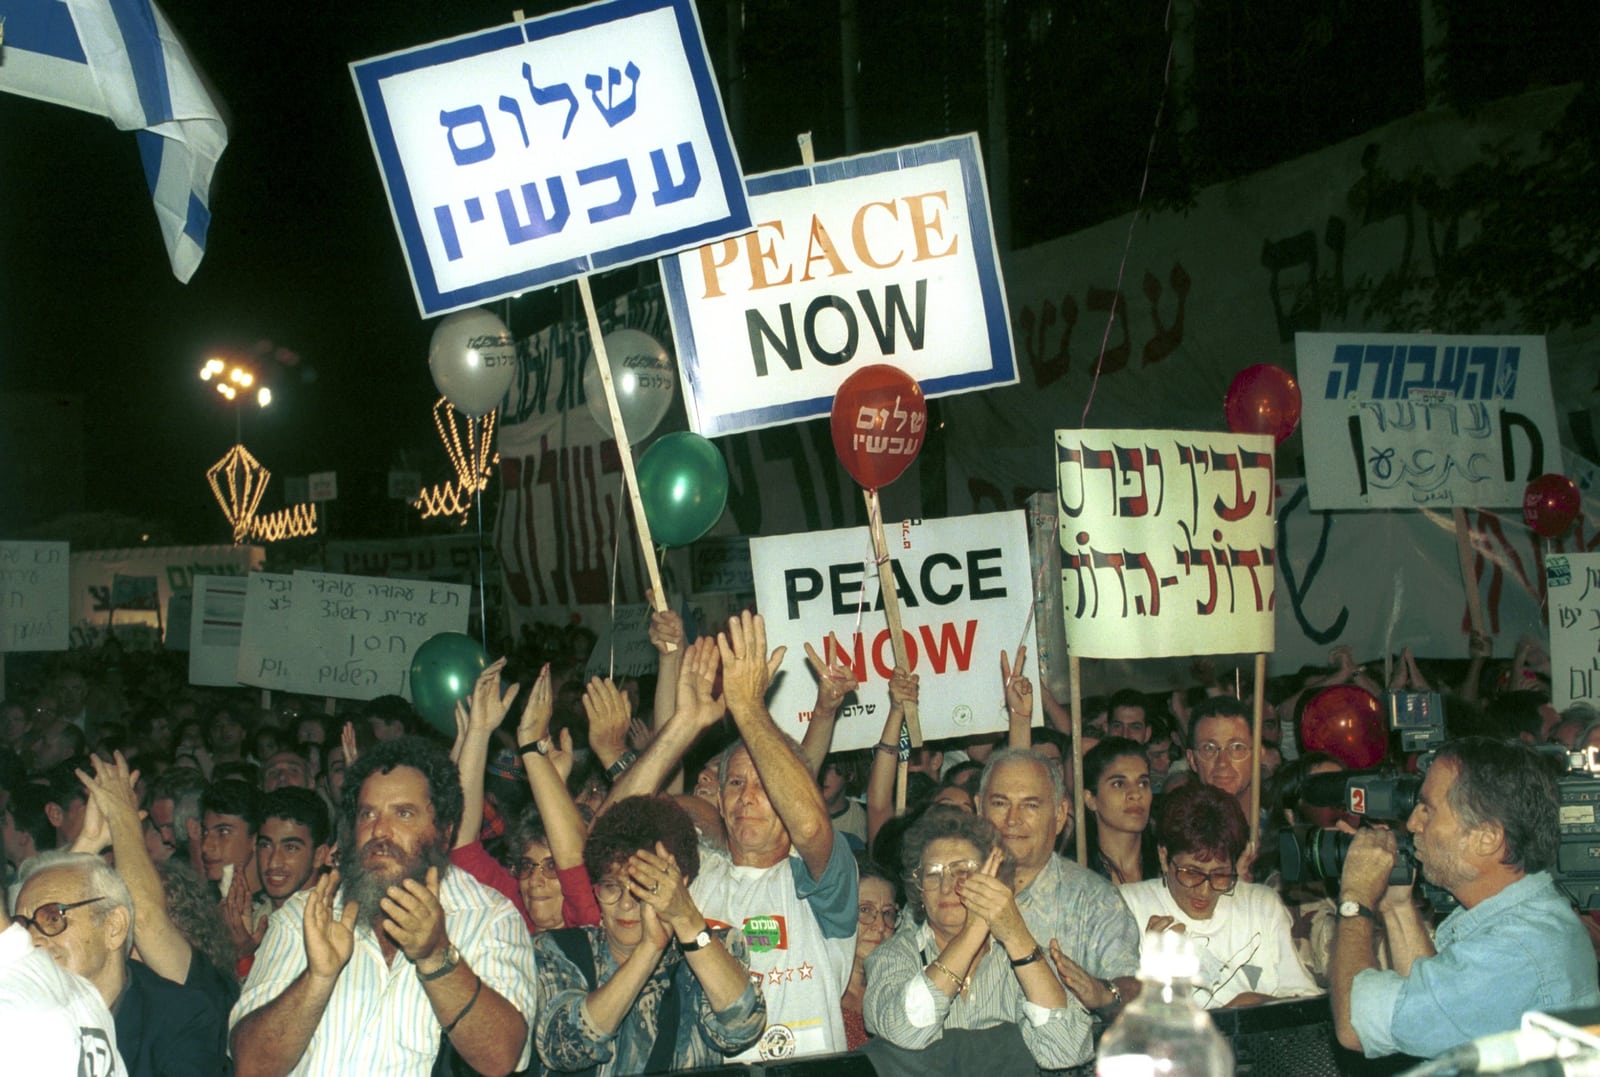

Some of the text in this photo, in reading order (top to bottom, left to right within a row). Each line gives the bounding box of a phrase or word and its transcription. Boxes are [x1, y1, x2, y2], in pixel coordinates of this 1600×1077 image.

[439, 60, 640, 166] שלום
[433, 141, 702, 262] עכשיו
[701, 190, 958, 299] PEACE
[745, 279, 928, 378] NOW
[1020, 262, 1191, 389] עכש
[1324, 344, 1520, 400] והעבודה
[853, 433, 919, 455] עכשיו
[856, 395, 924, 433] שלום
[1056, 440, 1273, 537] רבין ופרס
[784, 548, 1008, 620] PEACE
[319, 658, 378, 686] השלום
[350, 634, 406, 657] חסן
[823, 620, 978, 683] NOW
[843, 703, 876, 718] שלום
[750, 918, 777, 930] שלום
